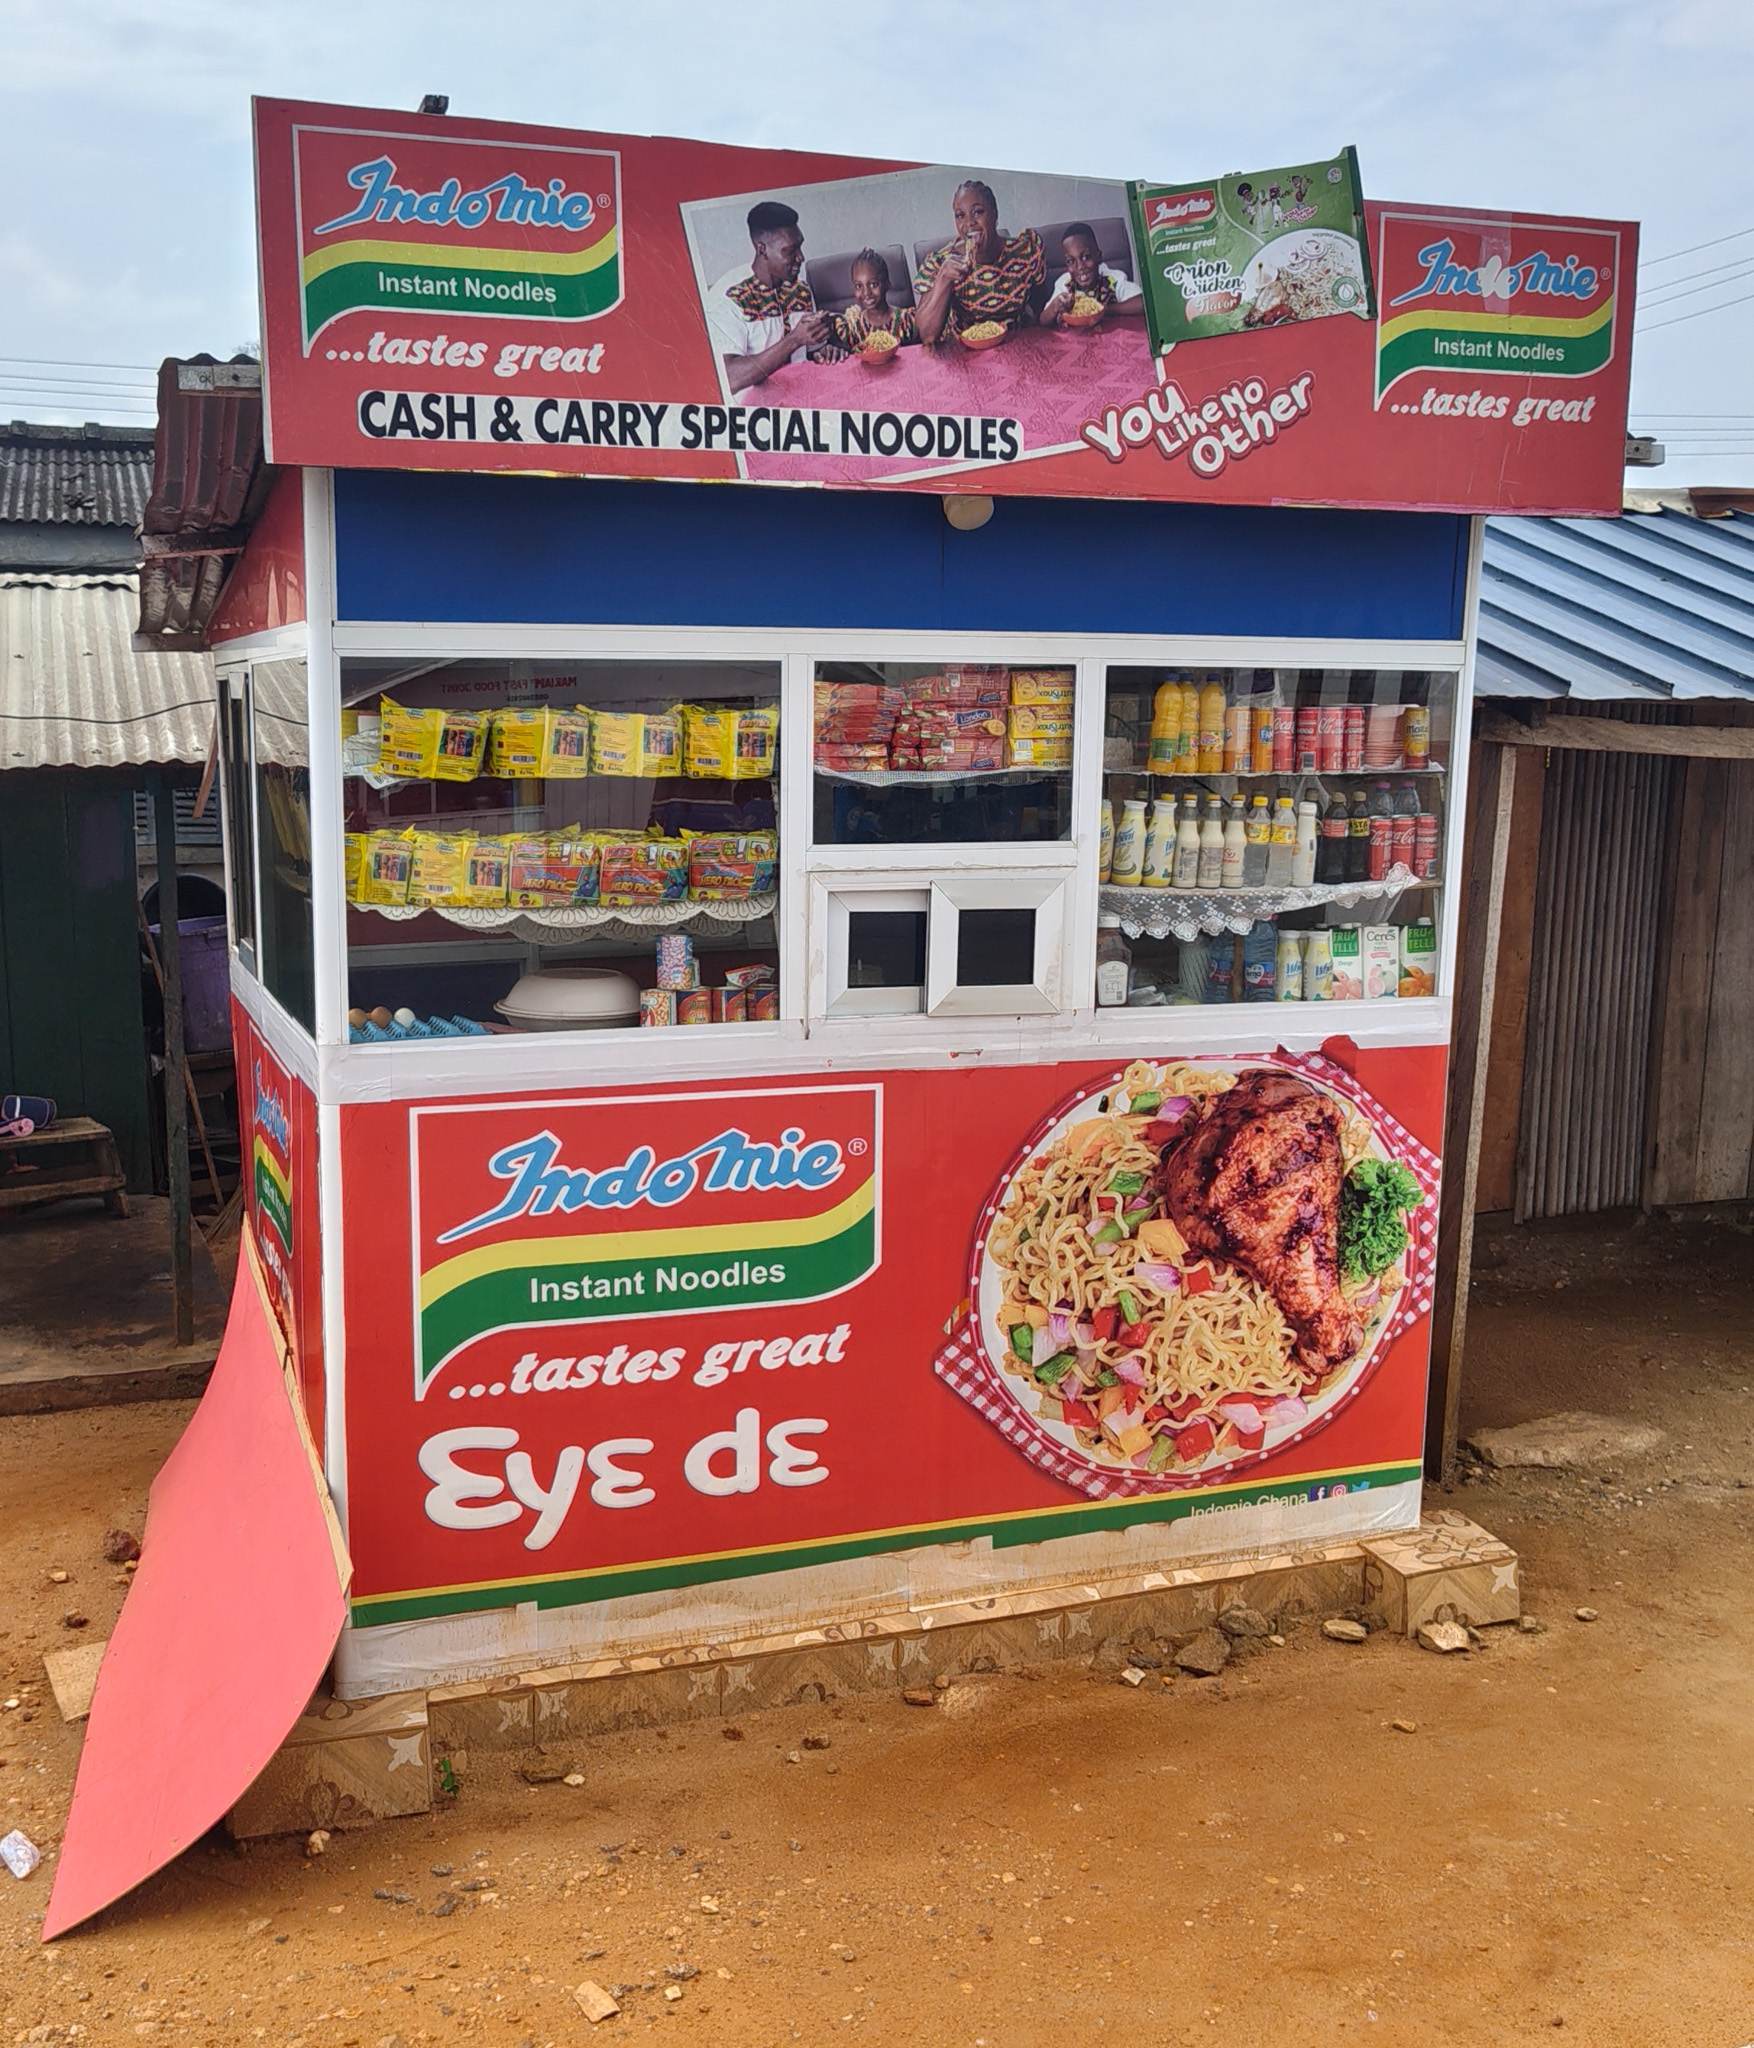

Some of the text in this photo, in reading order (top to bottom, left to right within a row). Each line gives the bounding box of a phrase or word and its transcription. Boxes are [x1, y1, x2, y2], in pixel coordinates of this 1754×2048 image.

[378, 271, 557, 304] Instant Noodles
[493, 343, 606, 378] great
[1434, 337, 1565, 361] Instant Noodles
[360, 390, 1019, 462] CASH & CARRY SPECIAL NOODLES
[1156, 401, 1223, 453] Like
[1192, 376, 1312, 473] Other
[1512, 396, 1596, 427] great
[1366, 930, 1396, 942] Ceres
[529, 1260, 787, 1304] Instant Noodles
[693, 1323, 852, 1388] great
